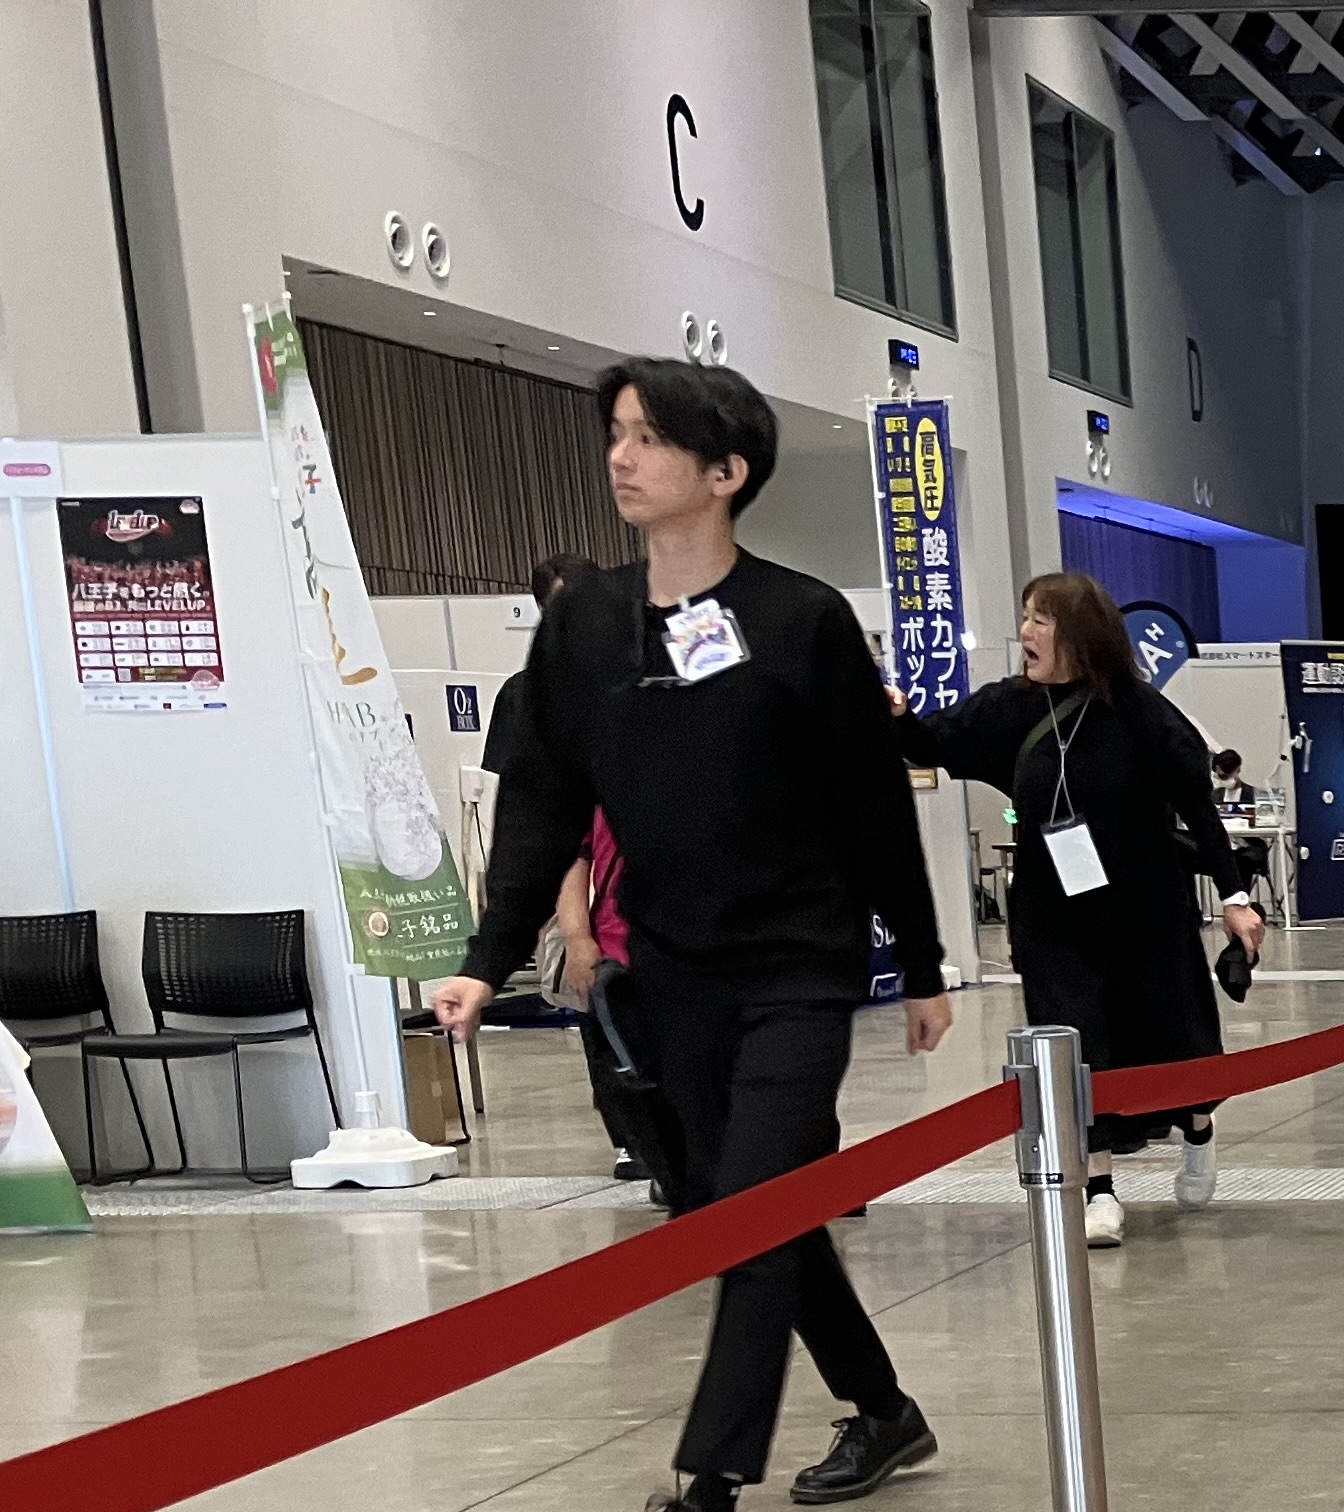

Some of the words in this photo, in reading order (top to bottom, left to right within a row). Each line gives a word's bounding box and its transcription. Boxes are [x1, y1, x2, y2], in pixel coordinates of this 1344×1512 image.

[666, 93, 705, 232] C
[919, 431, 940, 512] 高気圧
